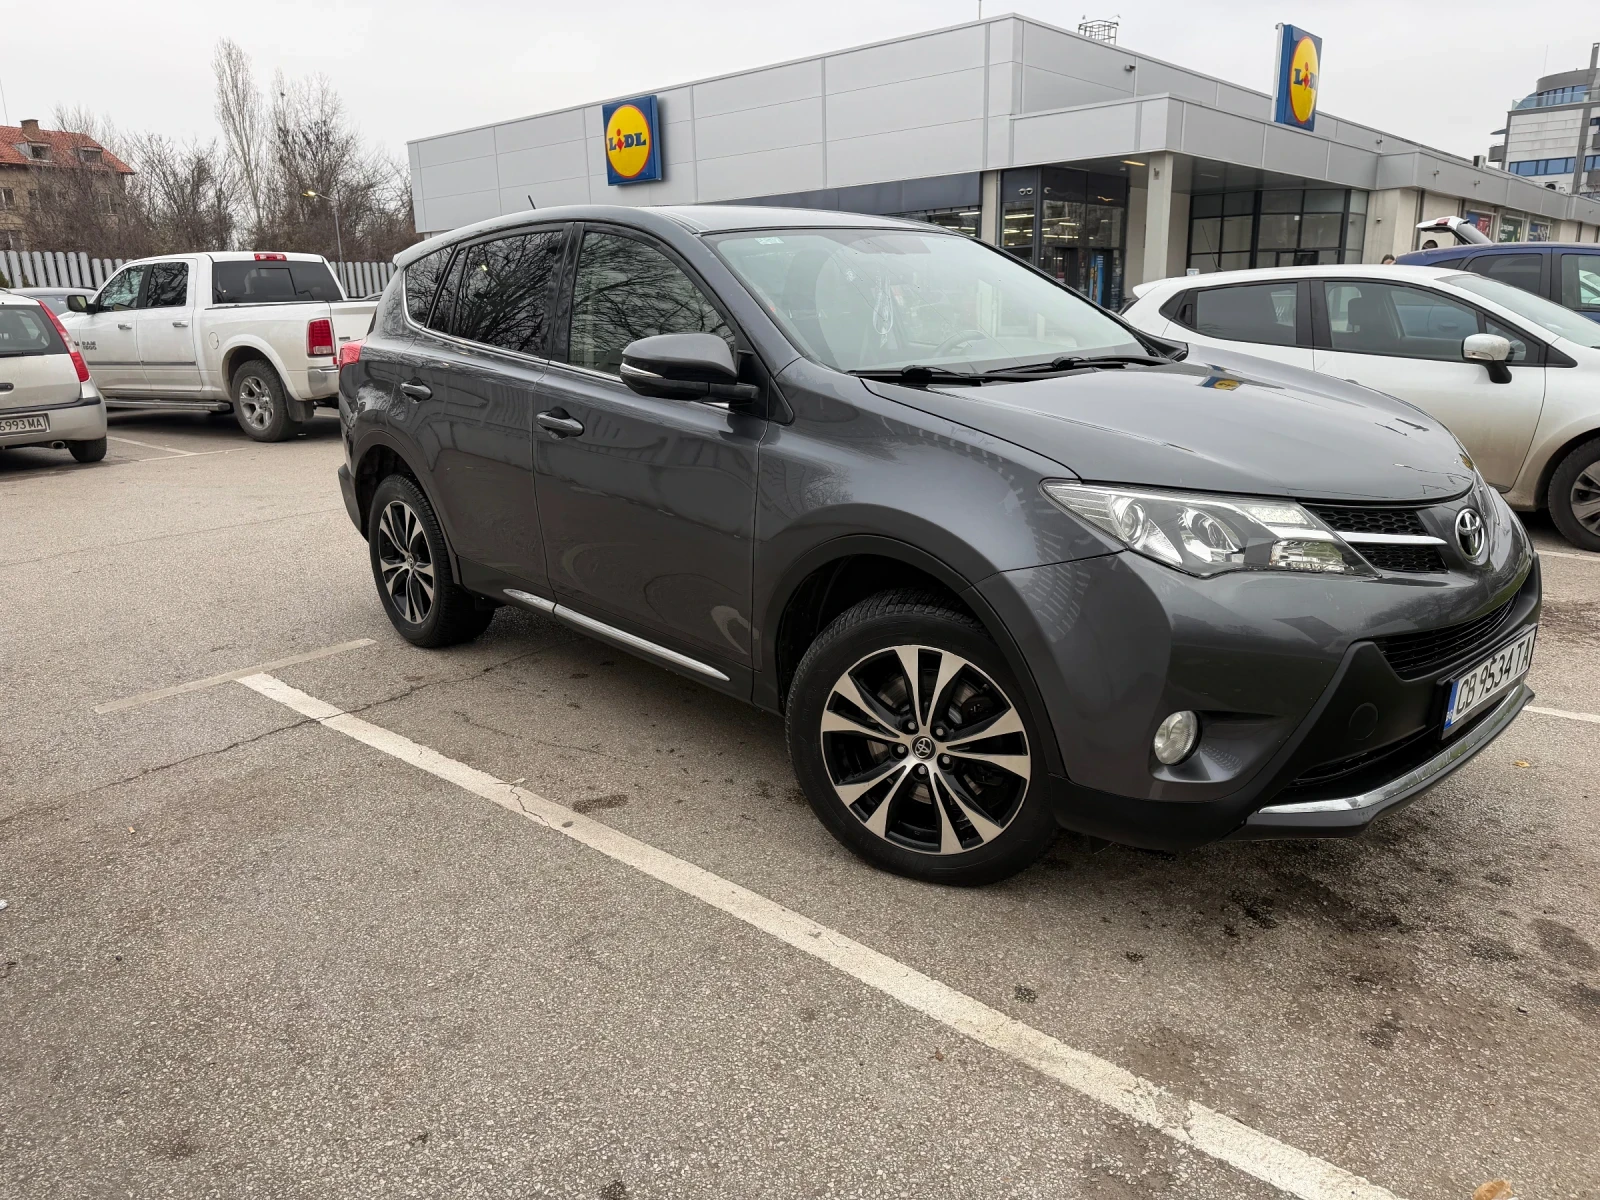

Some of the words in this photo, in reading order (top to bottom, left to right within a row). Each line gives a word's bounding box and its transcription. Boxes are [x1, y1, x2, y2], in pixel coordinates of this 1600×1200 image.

[27, 418, 43, 428] MA
[1456, 673, 1477, 715] CB
[1478, 648, 1514, 699] 9534
[1515, 637, 1530, 674] TA
